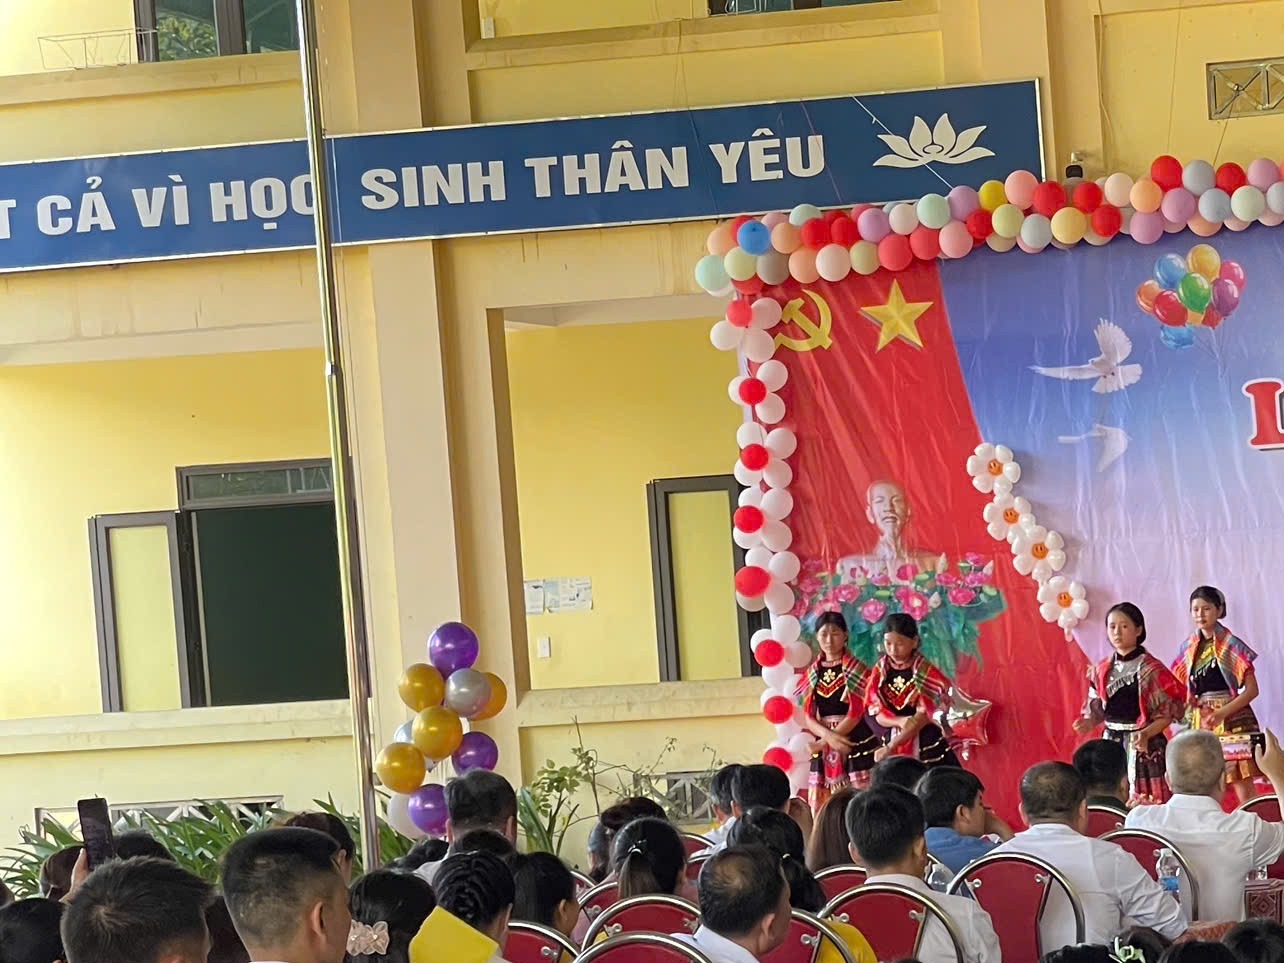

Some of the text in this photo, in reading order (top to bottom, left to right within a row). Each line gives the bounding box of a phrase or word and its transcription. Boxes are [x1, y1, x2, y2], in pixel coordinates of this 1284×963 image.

[36, 176, 116, 236] CẢ
[132, 175, 190, 228] VÌ
[360, 160, 507, 211] SINH
[525, 140, 690, 198] THÂN
[708, 128, 826, 184] YÊU
